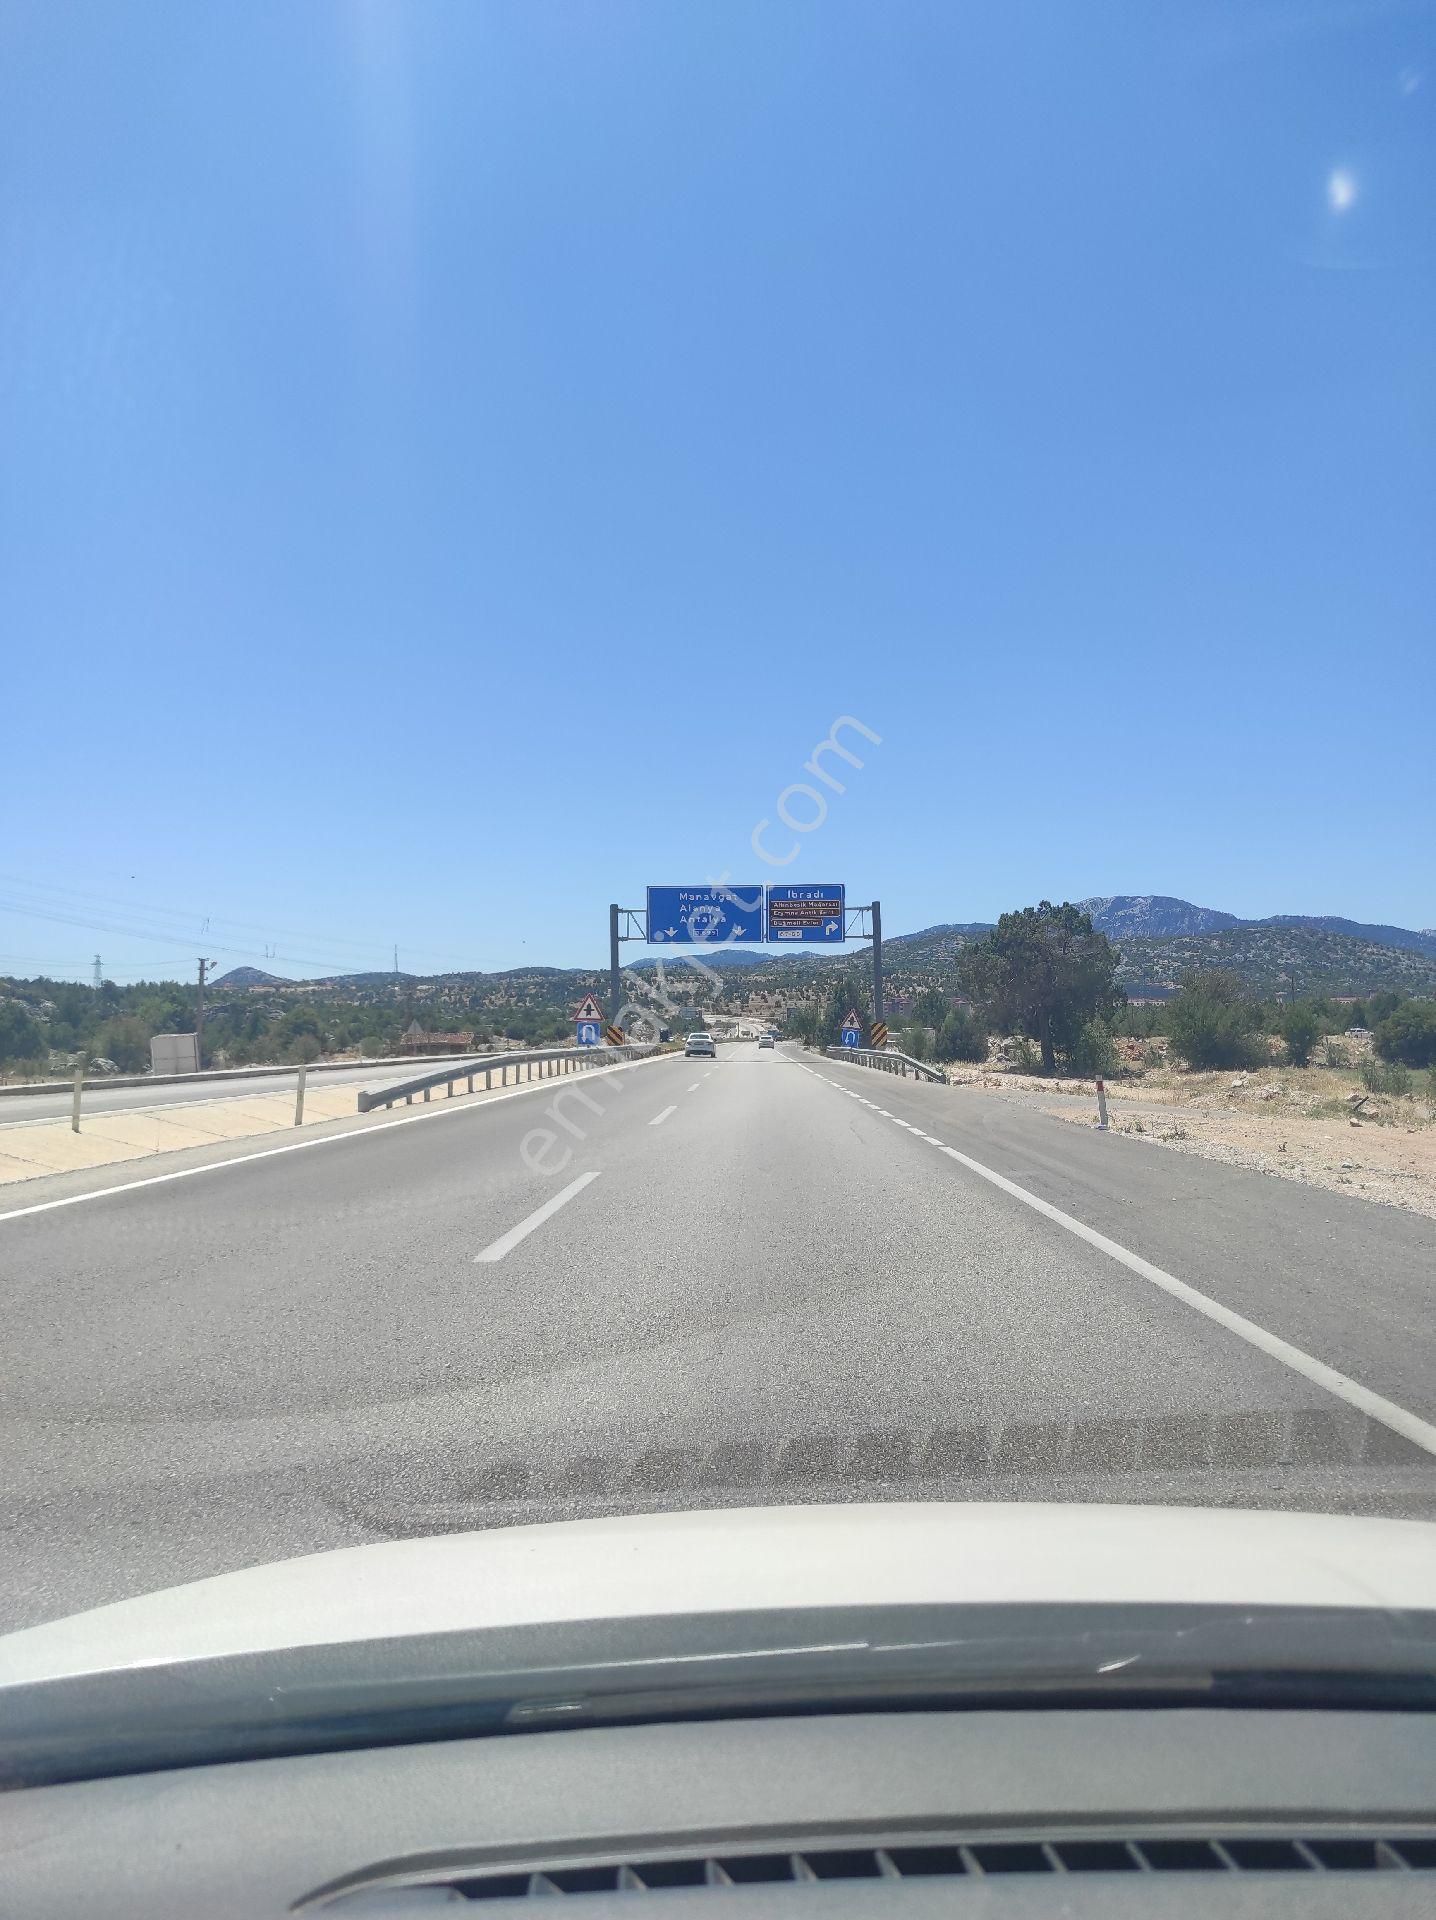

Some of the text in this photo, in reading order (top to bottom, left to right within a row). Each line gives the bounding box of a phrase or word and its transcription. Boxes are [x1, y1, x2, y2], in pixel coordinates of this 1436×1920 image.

[679, 891, 738, 902] Manavgat
[679, 904, 721, 914] Alanya
[679, 915, 727, 925] Antalya
